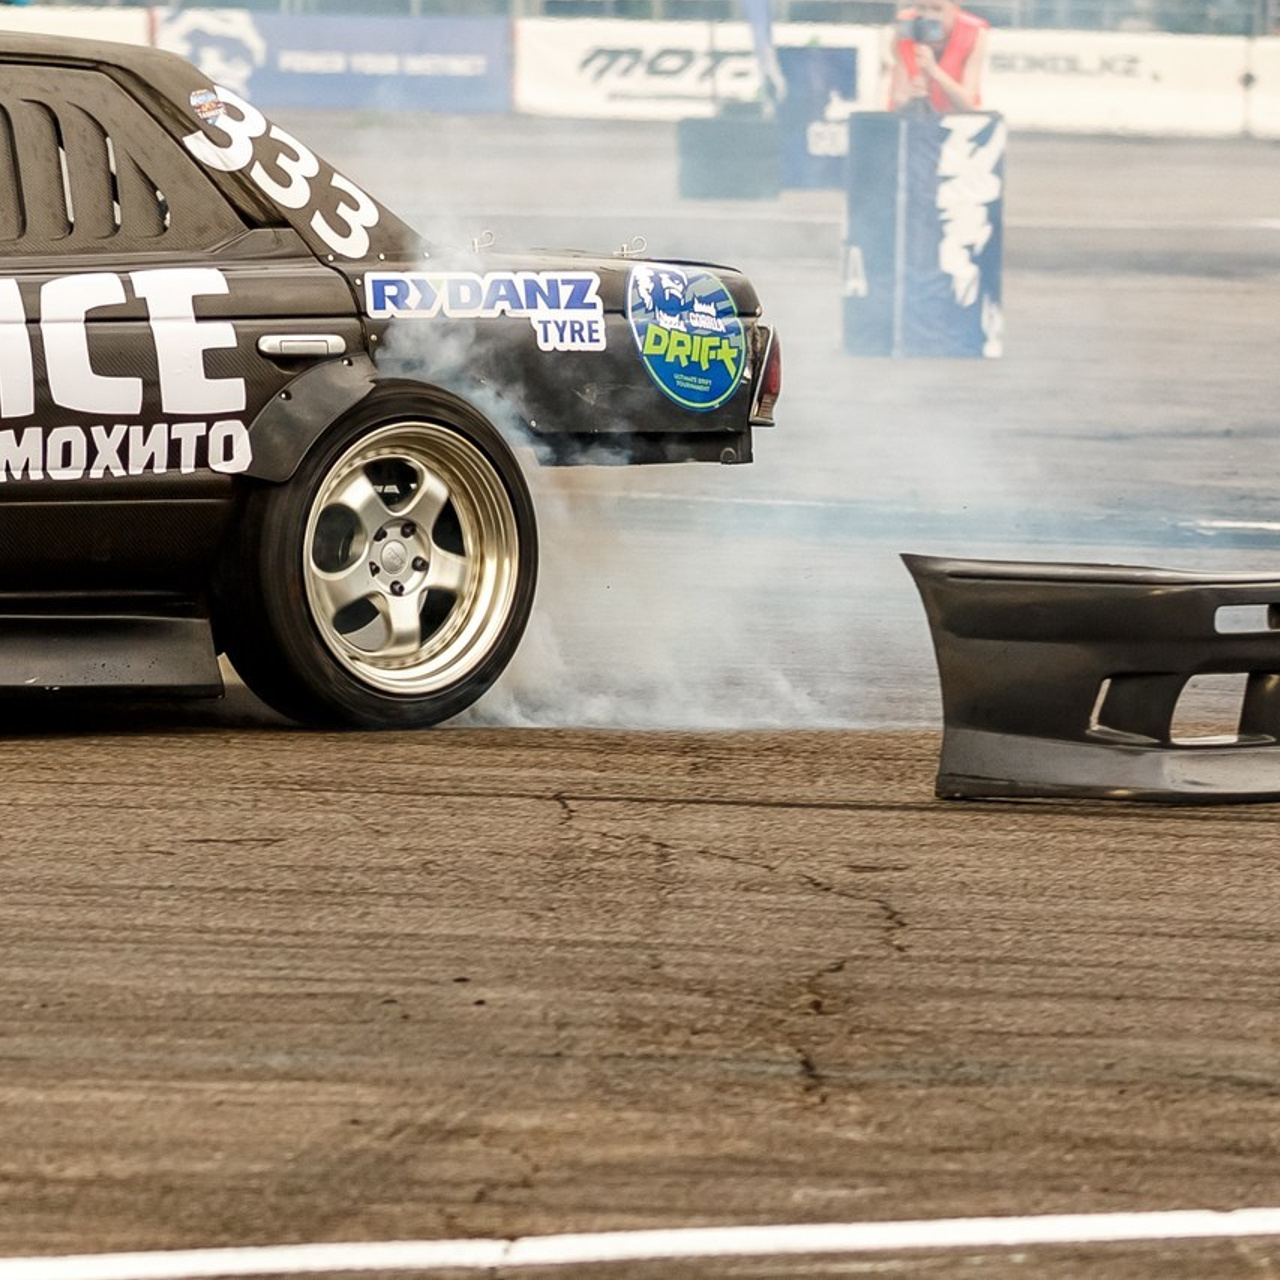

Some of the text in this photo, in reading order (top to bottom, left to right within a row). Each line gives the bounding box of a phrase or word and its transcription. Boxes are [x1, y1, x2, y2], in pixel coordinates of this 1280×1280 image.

[183, 85, 380, 259] 333
[371, 278, 598, 311] RYDANZ
[538, 320, 601, 343] TYRE
[643, 323, 739, 380] DRIFT
